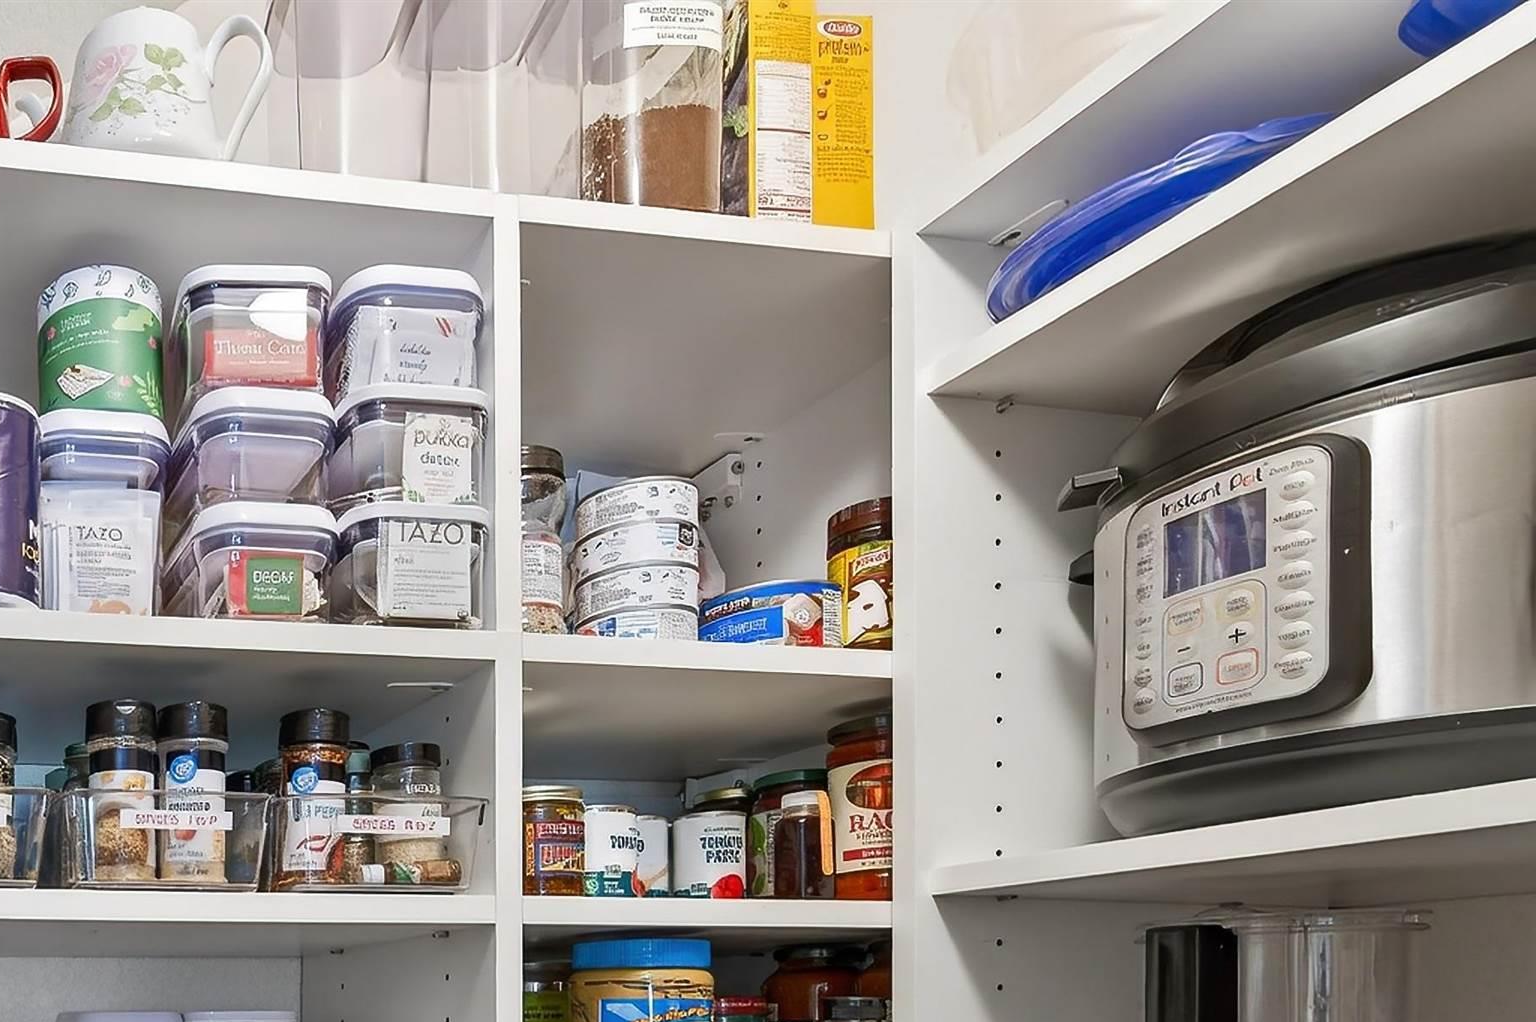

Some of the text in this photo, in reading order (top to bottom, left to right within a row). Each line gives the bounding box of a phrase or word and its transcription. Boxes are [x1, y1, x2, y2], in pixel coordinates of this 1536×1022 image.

[414, 429, 469, 448] pukka
[1161, 467, 1264, 517] Instant Pot
[76, 525, 123, 541] TAZO
[396, 522, 464, 546] TAZO
